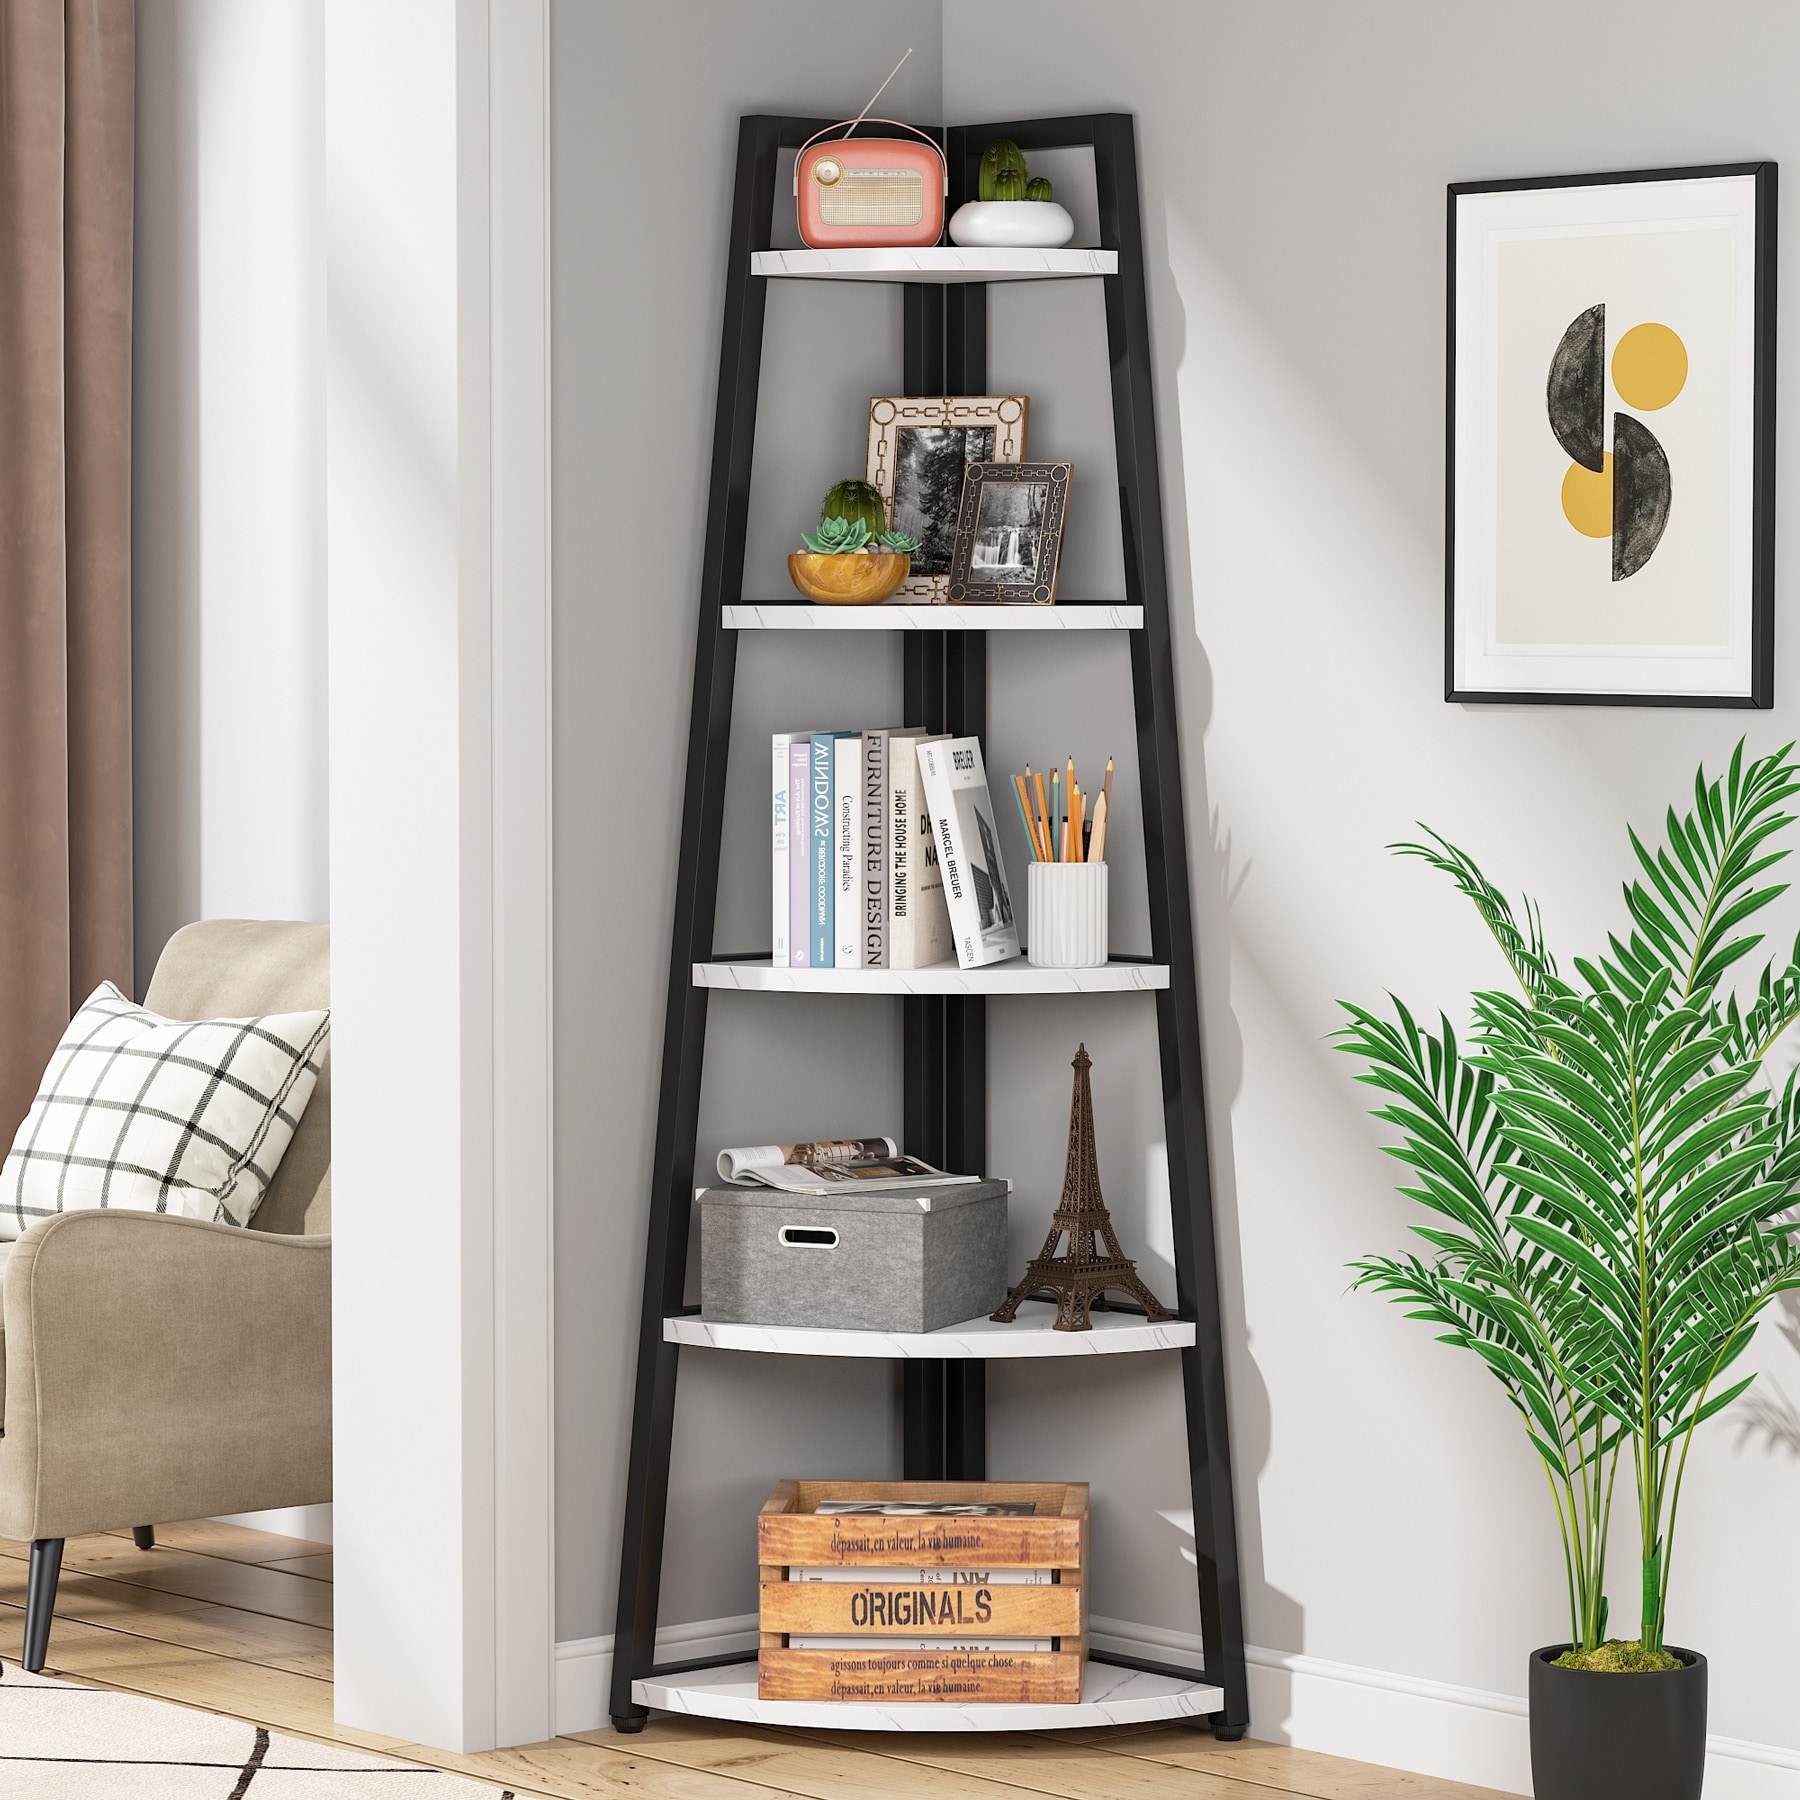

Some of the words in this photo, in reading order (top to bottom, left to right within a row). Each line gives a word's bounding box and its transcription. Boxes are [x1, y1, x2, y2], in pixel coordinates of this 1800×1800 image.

[952, 750, 975, 770] BREUER
[867, 735, 882, 871] FURNITURE
[894, 789, 906, 815] HOME
[840, 795, 853, 851] Constructing
[894, 818, 906, 848] HOUSE
[842, 854, 853, 891] Paradies
[894, 851, 906, 869] THE
[939, 819, 953, 858] MARCEL
[947, 860, 962, 899] BREUER
[894, 872, 906, 916] BRINGING
[867, 880, 882, 965] DESIGN
[964, 936, 974, 962] TASCEN
[918, 1530, 926, 1550] la
[852, 1589, 992, 1626] ORIGINALS
[830, 1658, 866, 1677] agissons
[868, 1656, 906, 1674] toujours
[907, 1659, 940, 1670] comme
[941, 1656, 949, 1669] si
[951, 1654, 986, 1674] quelque
[988, 1654, 1013, 1668] chose
[918, 1679, 926, 1694] la
